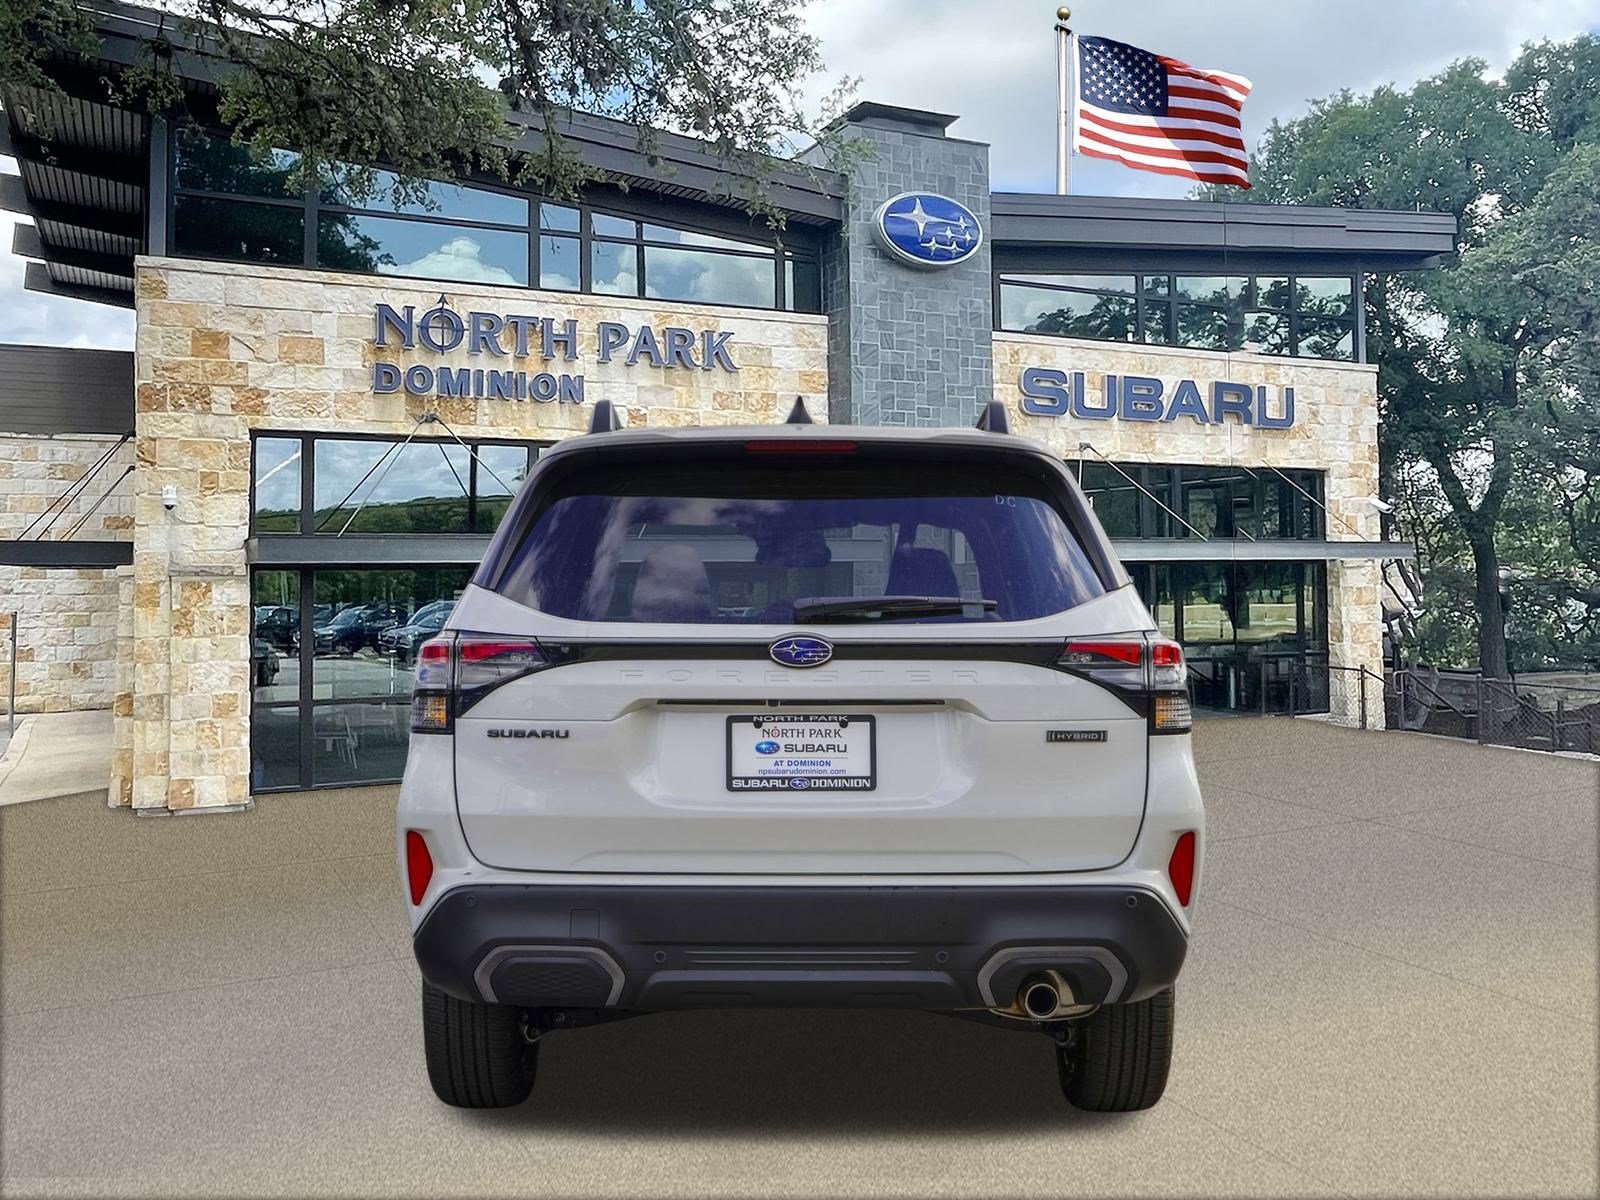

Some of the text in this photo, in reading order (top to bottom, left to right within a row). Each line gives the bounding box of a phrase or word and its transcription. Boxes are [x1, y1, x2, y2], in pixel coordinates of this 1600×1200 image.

[375, 294, 741, 372] NORTH PARK
[373, 362, 585, 404] DOMINION
[1018, 366, 1295, 430] SUBARU
[618, 668, 979, 684] FORESTER
[486, 728, 570, 739] SUBARU
[761, 727, 842, 738] NORTH PARK
[1056, 732, 1100, 741] HYBRID
[783, 743, 848, 753] SUBARU
[758, 768, 847, 776] npsubarudominion.com
[732, 778, 871, 788] SUBARU DOMINION
